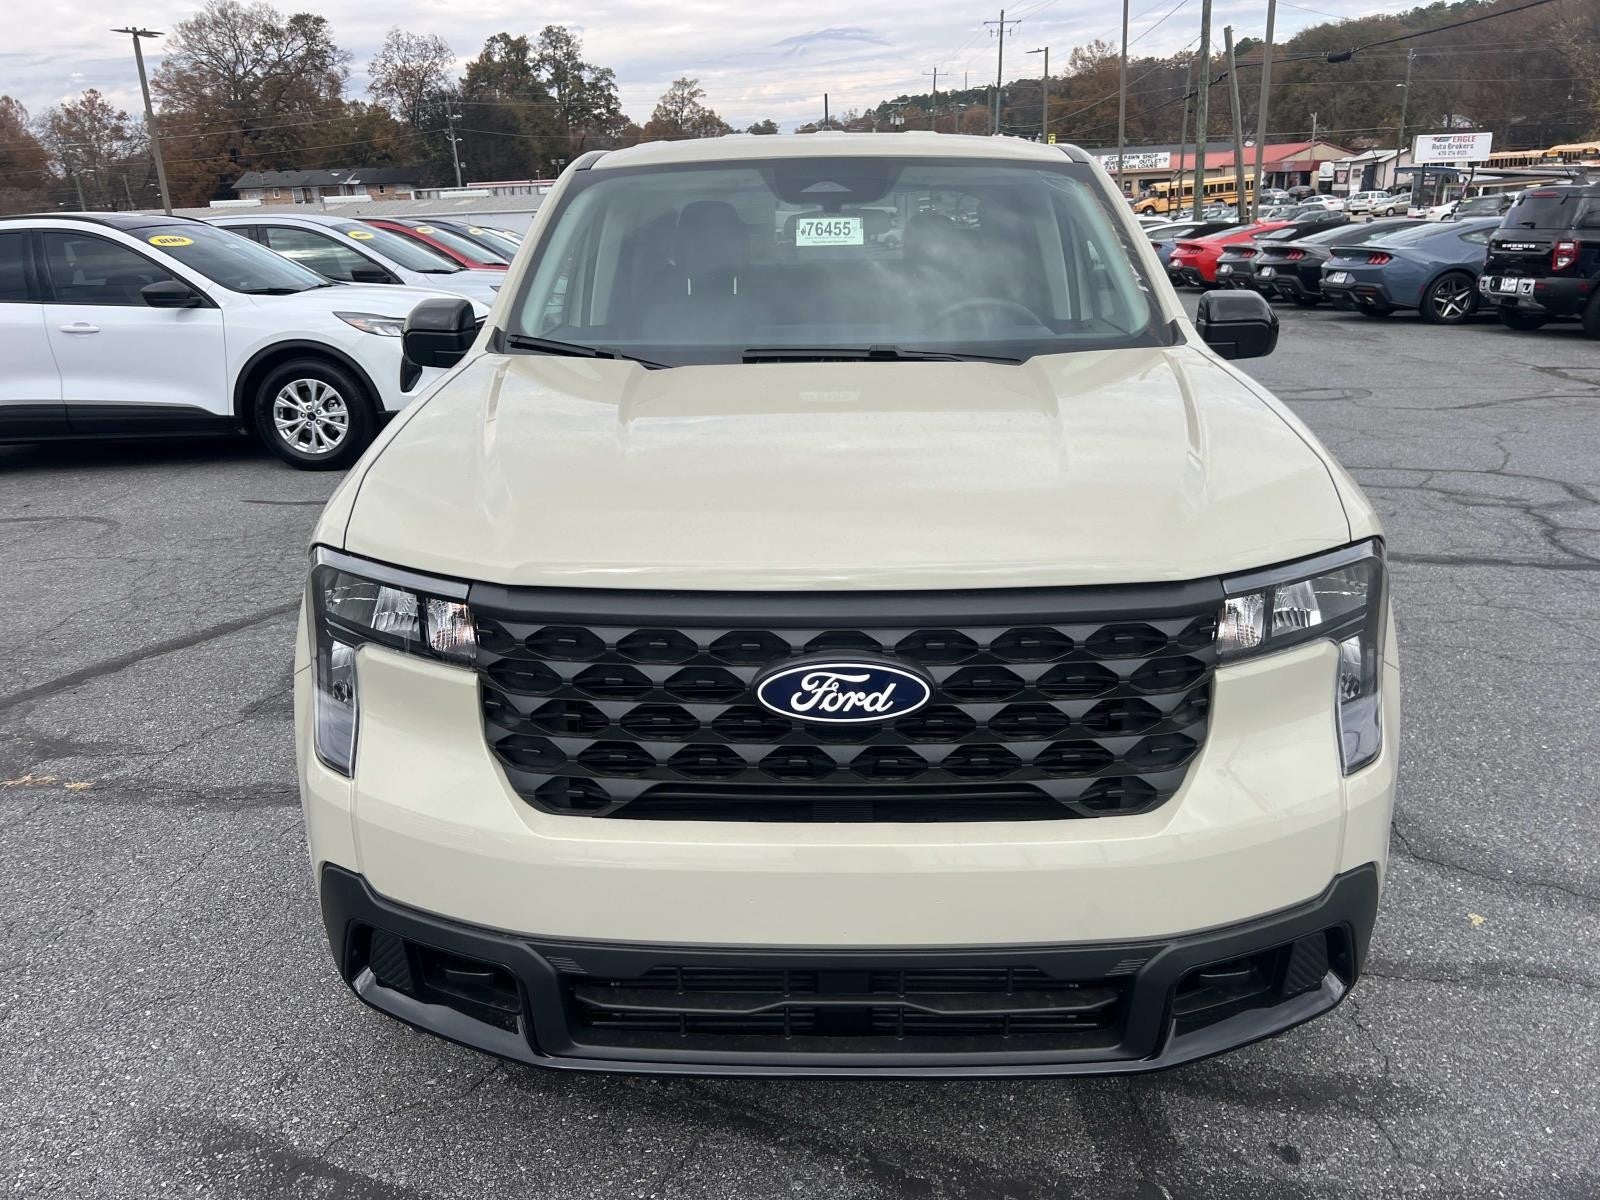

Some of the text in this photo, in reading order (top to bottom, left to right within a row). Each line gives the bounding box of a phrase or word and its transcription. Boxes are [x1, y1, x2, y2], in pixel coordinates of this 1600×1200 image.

[1452, 135, 1477, 143] EAGLE
[1447, 142, 1474, 150] Brokers
[790, 671, 896, 713] Ford
